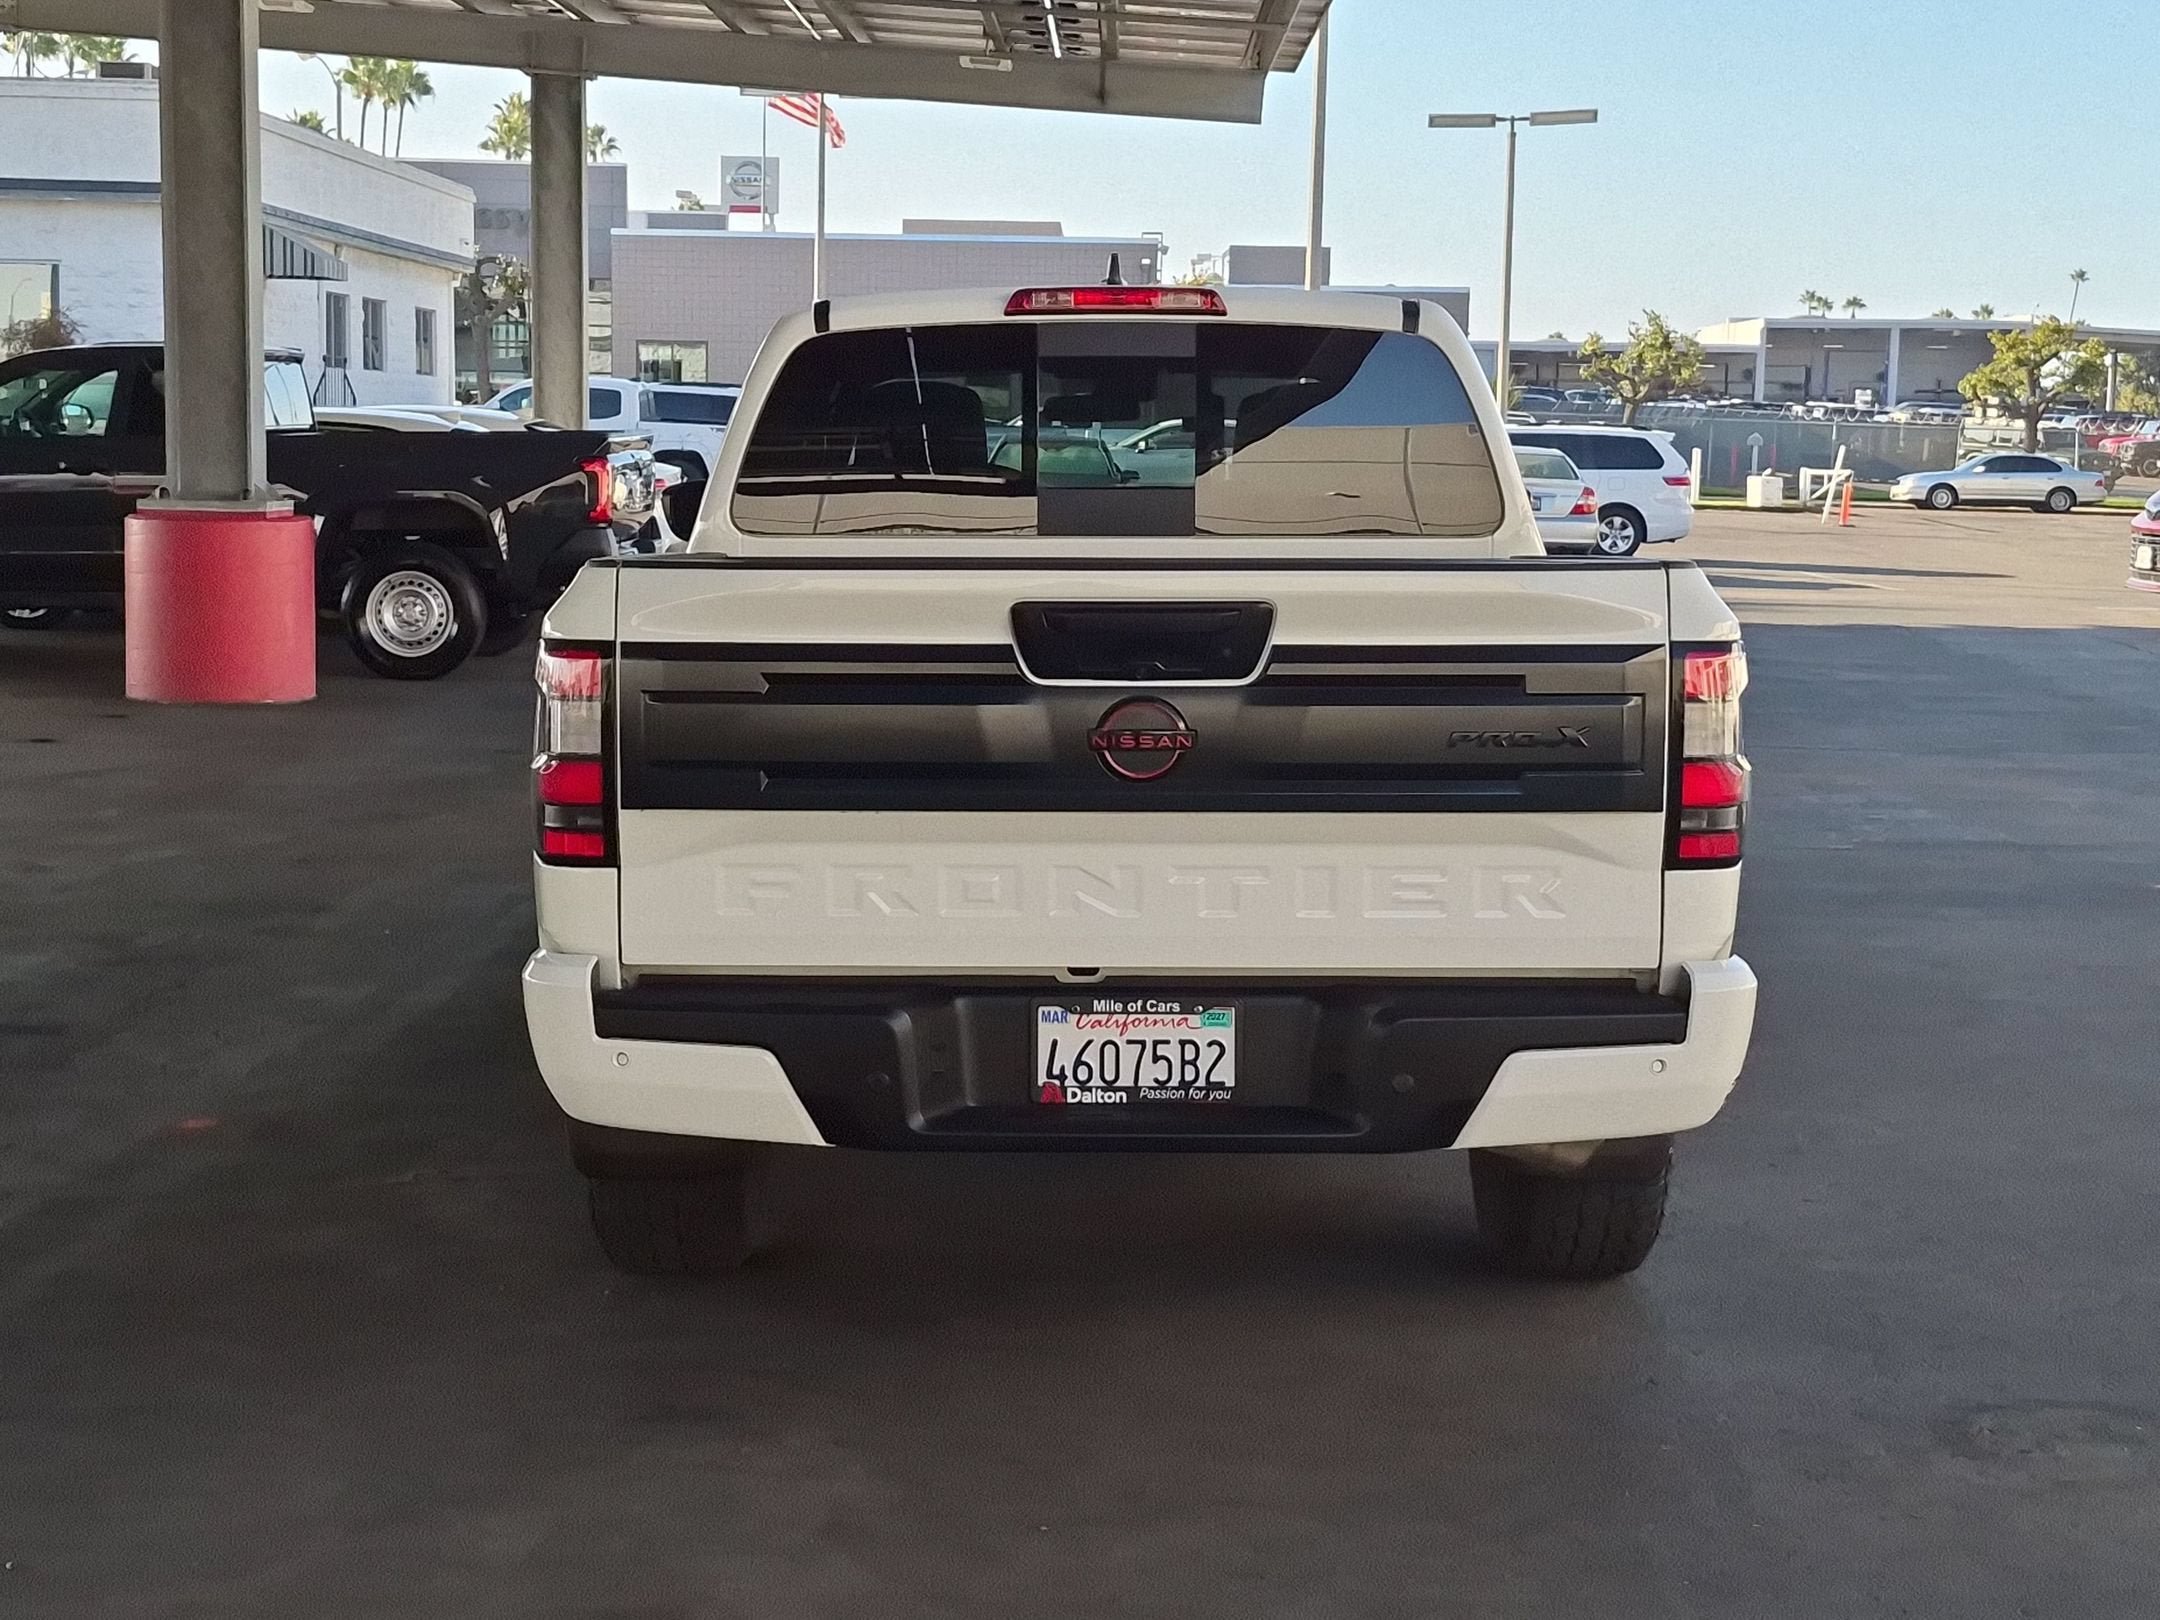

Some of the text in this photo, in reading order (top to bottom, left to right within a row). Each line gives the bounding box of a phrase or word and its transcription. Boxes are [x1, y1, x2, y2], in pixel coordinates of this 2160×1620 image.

[1091, 735, 1193, 748] NISSAN
[716, 863, 1567, 919] FRONTIER
[1093, 999, 1180, 1012] Mile of Cars
[1041, 1010, 1069, 1023] MAR
[1076, 1014, 1203, 1036] California
[1046, 1039, 1226, 1086] 46075B2
[1067, 1087, 1127, 1104] Dalton
[1140, 1087, 1231, 1100] Passion for you
